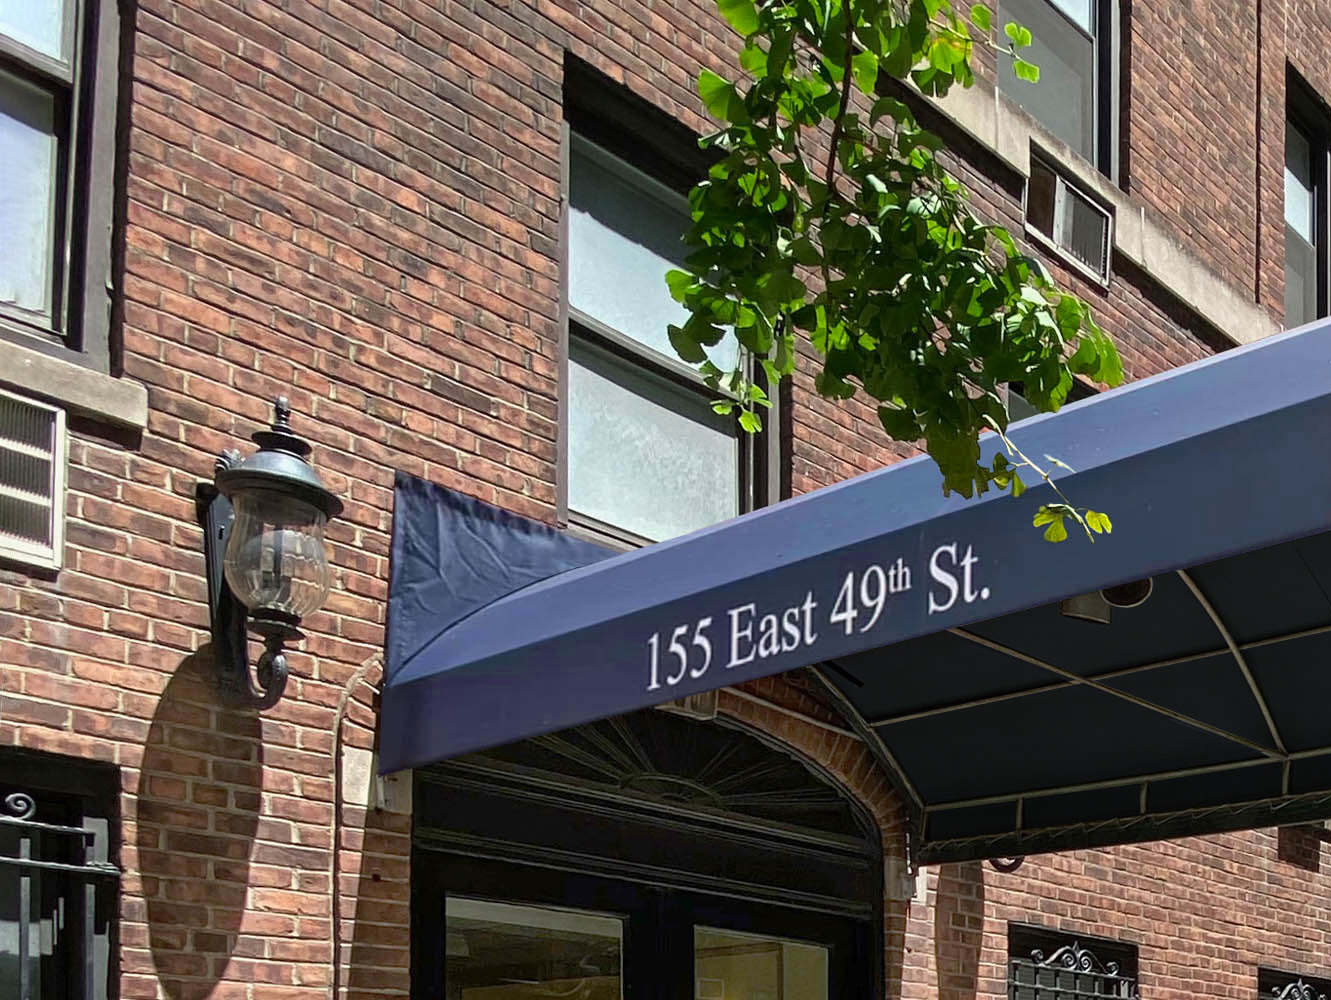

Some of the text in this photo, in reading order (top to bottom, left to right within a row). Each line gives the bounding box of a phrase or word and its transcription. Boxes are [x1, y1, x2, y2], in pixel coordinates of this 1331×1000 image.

[646, 543, 990, 691] 155 East 49th St.
